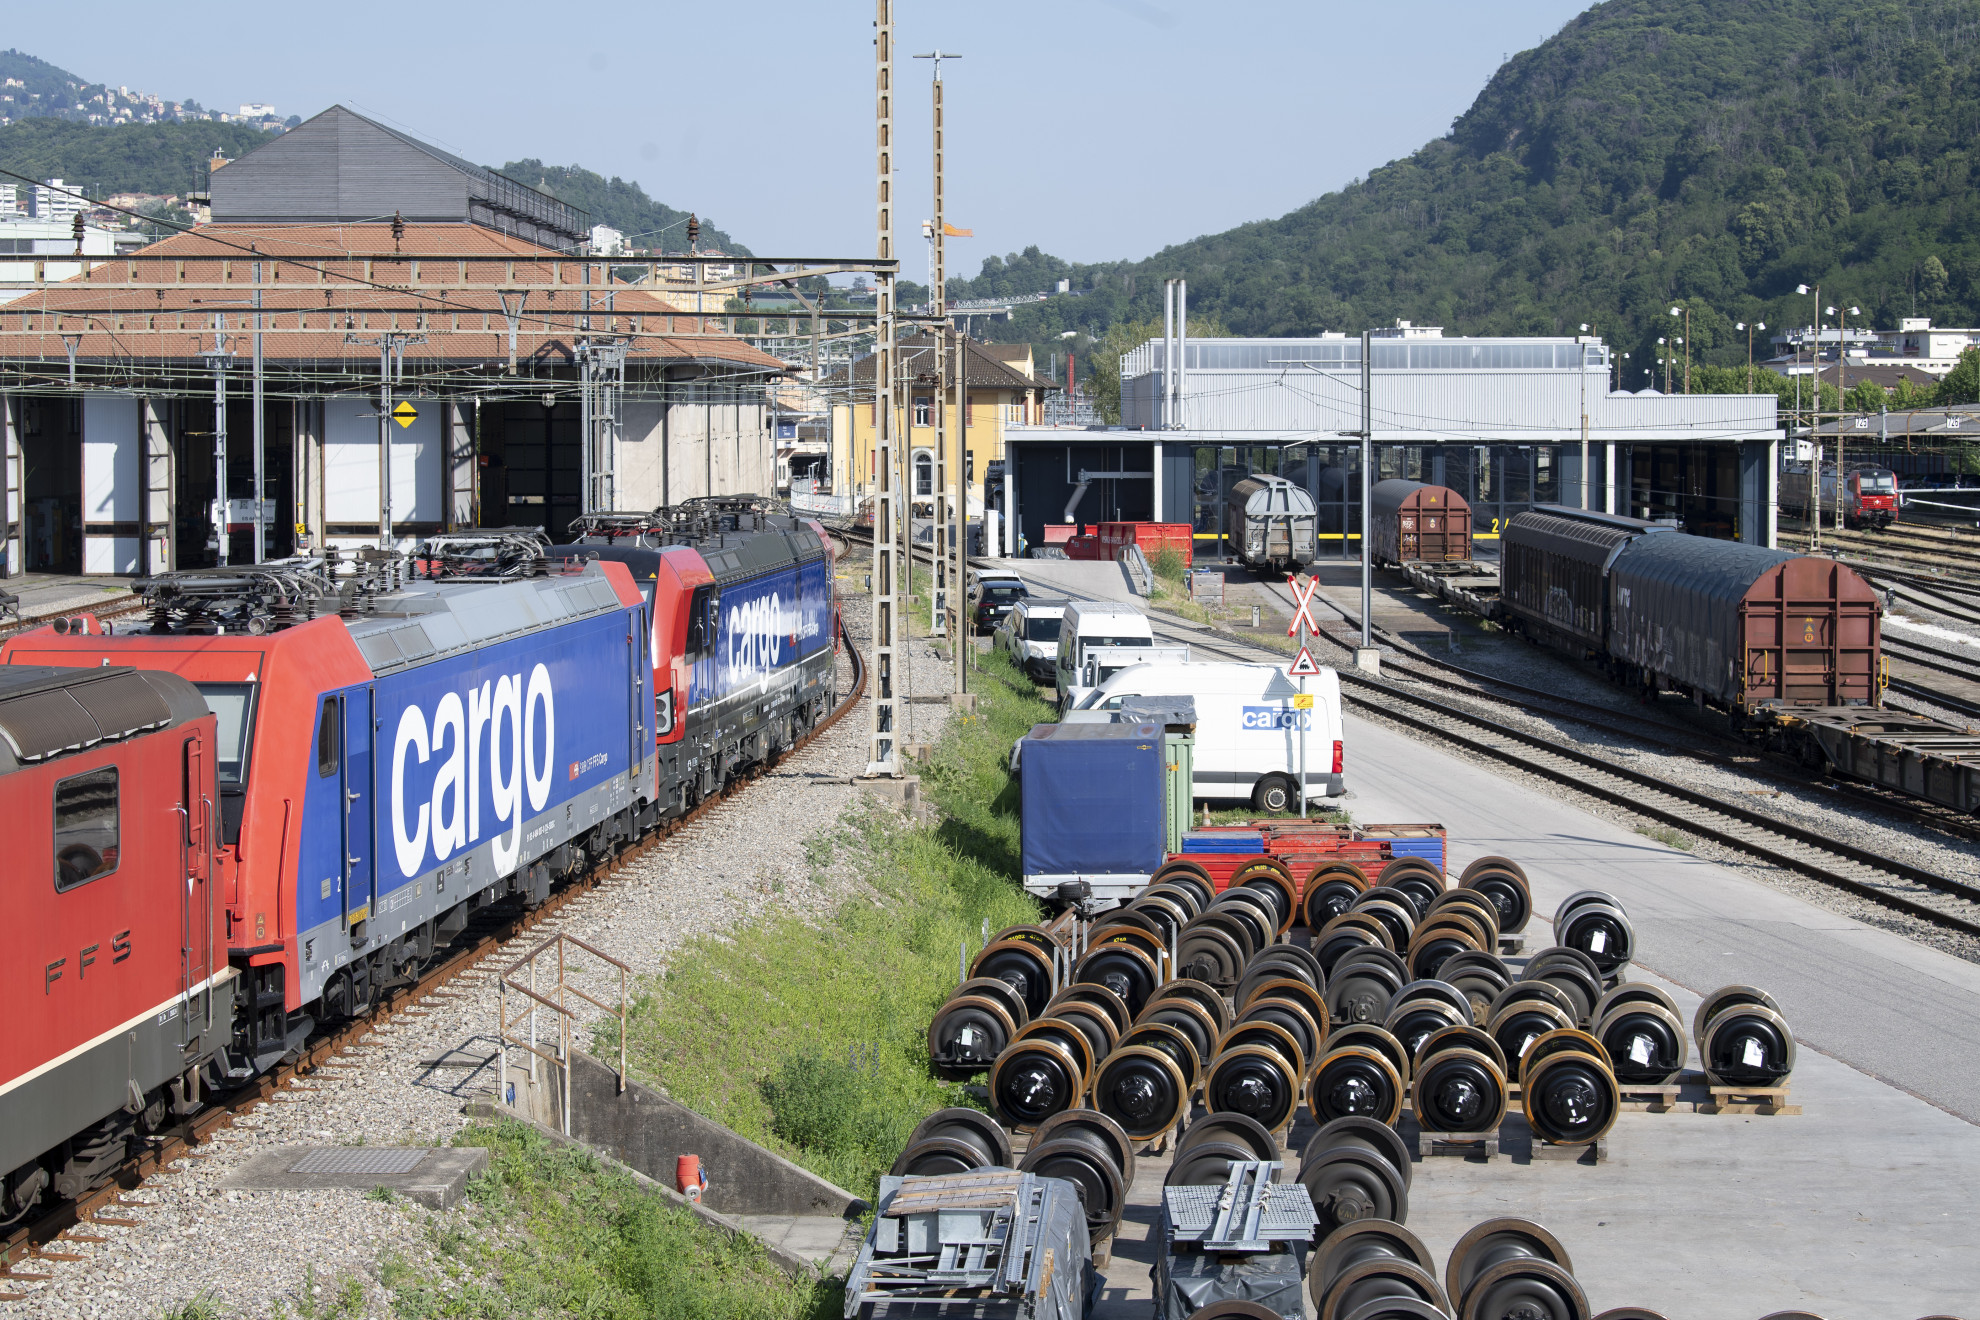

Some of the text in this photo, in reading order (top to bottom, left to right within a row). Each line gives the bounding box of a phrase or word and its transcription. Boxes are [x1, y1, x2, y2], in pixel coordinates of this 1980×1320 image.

[729, 591, 780, 695] cargo
[1243, 711, 1312, 731] cargo
[392, 663, 555, 878] cargo
[46, 930, 131, 995] FFS
